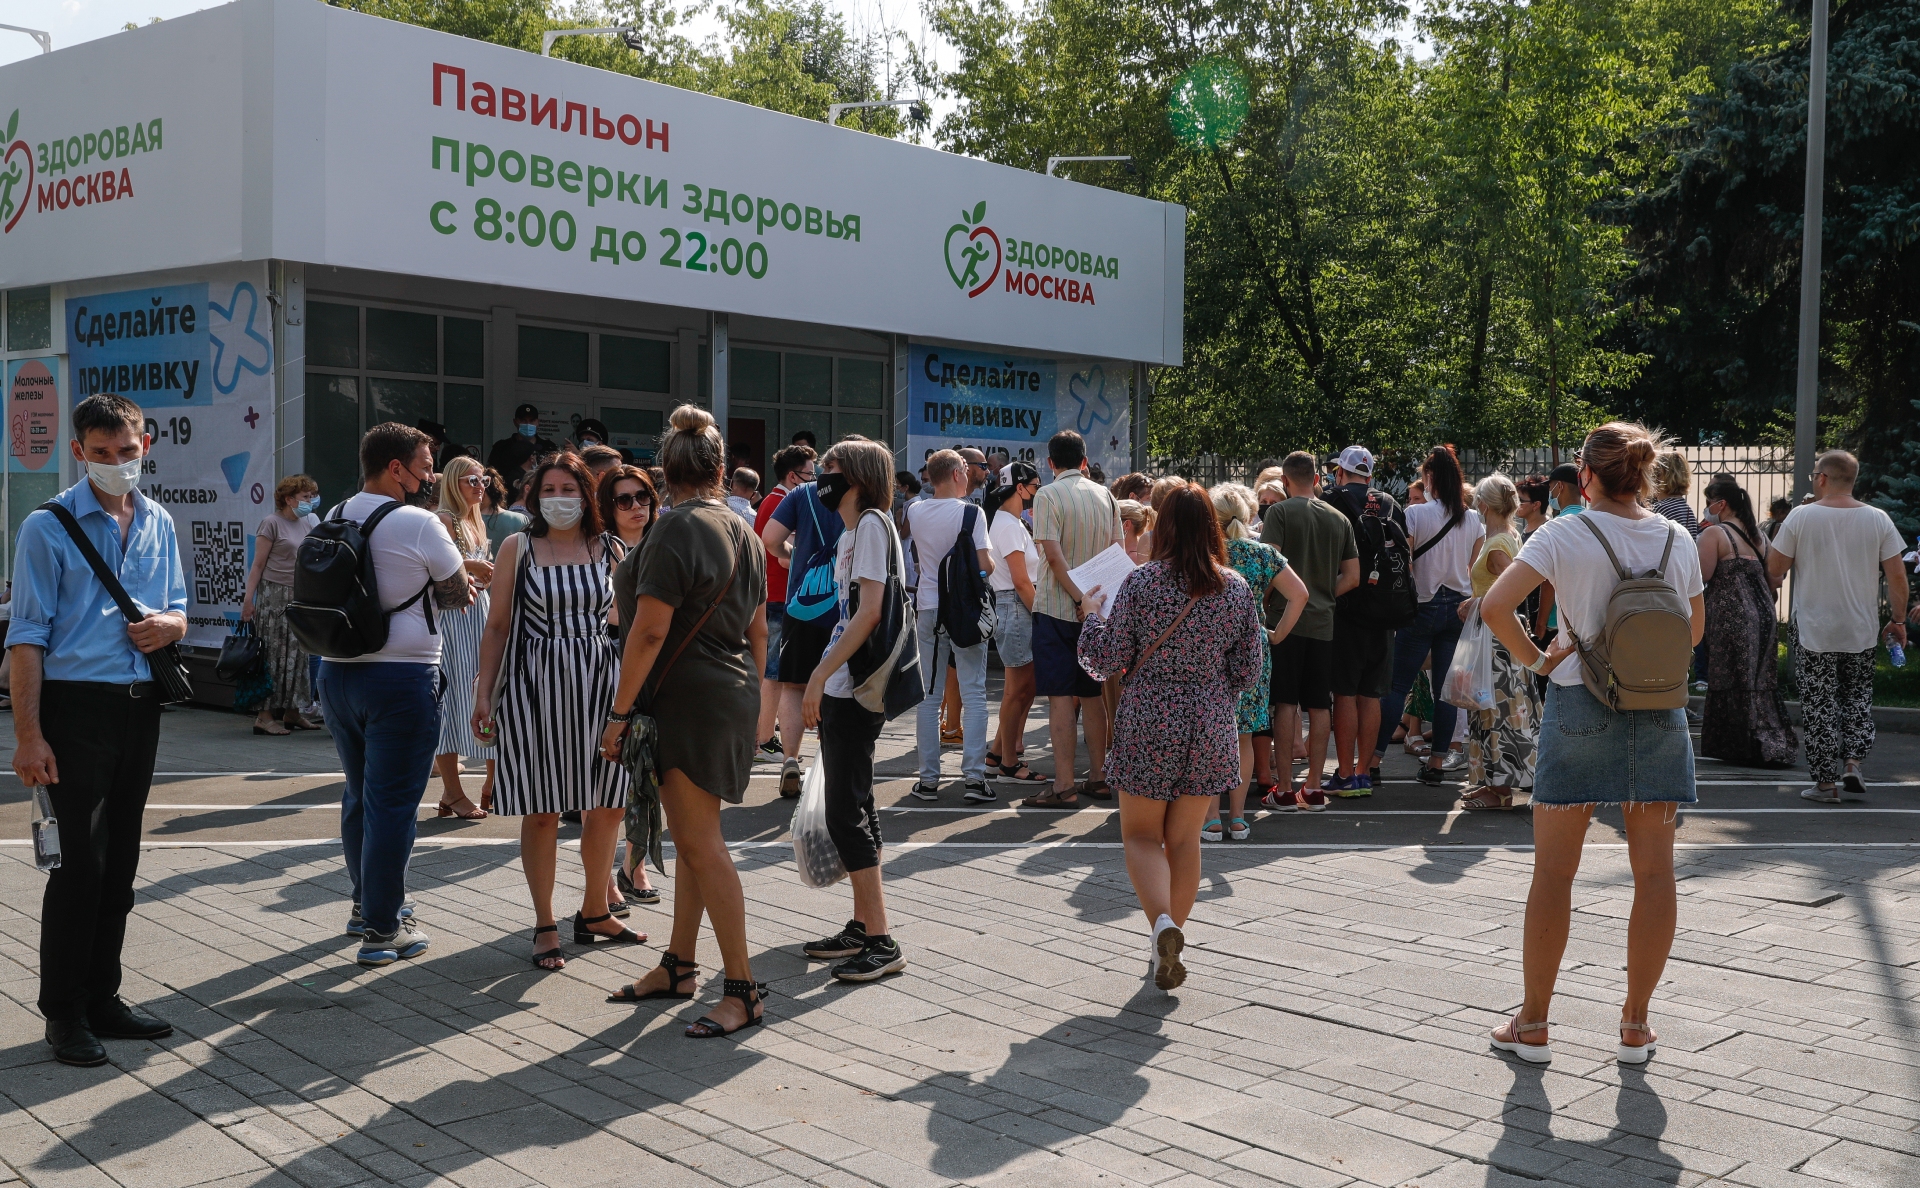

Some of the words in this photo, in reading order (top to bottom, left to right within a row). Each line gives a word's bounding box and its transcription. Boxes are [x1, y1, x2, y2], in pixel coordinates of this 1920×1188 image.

[431, 61, 670, 153] Павильон
[36, 117, 163, 177] ЗДОРОВАЯ
[37, 167, 134, 213] МОСКВА
[431, 135, 669, 209] проверки
[682, 183, 862, 243] здоровья
[429, 200, 458, 235] с
[473, 197, 577, 253] 8:00
[590, 225, 647, 266] до
[659, 227, 769, 280] 22:00
[1005, 237, 1119, 280] ЗДОРОВАЯ
[1005, 269, 1096, 305] МОСКВА
[74, 296, 196, 348] Сделайте
[14, 375, 54, 387] Молочные
[78, 360, 200, 400] прививку
[924, 353, 1041, 392] Сделайте
[14, 391, 44, 400] железы
[145, 416, 192, 445] D-19
[923, 401, 1042, 437] прививку
[151, 483, 218, 504] Москва»
[187, 616, 241, 628] osgorzdrav.
